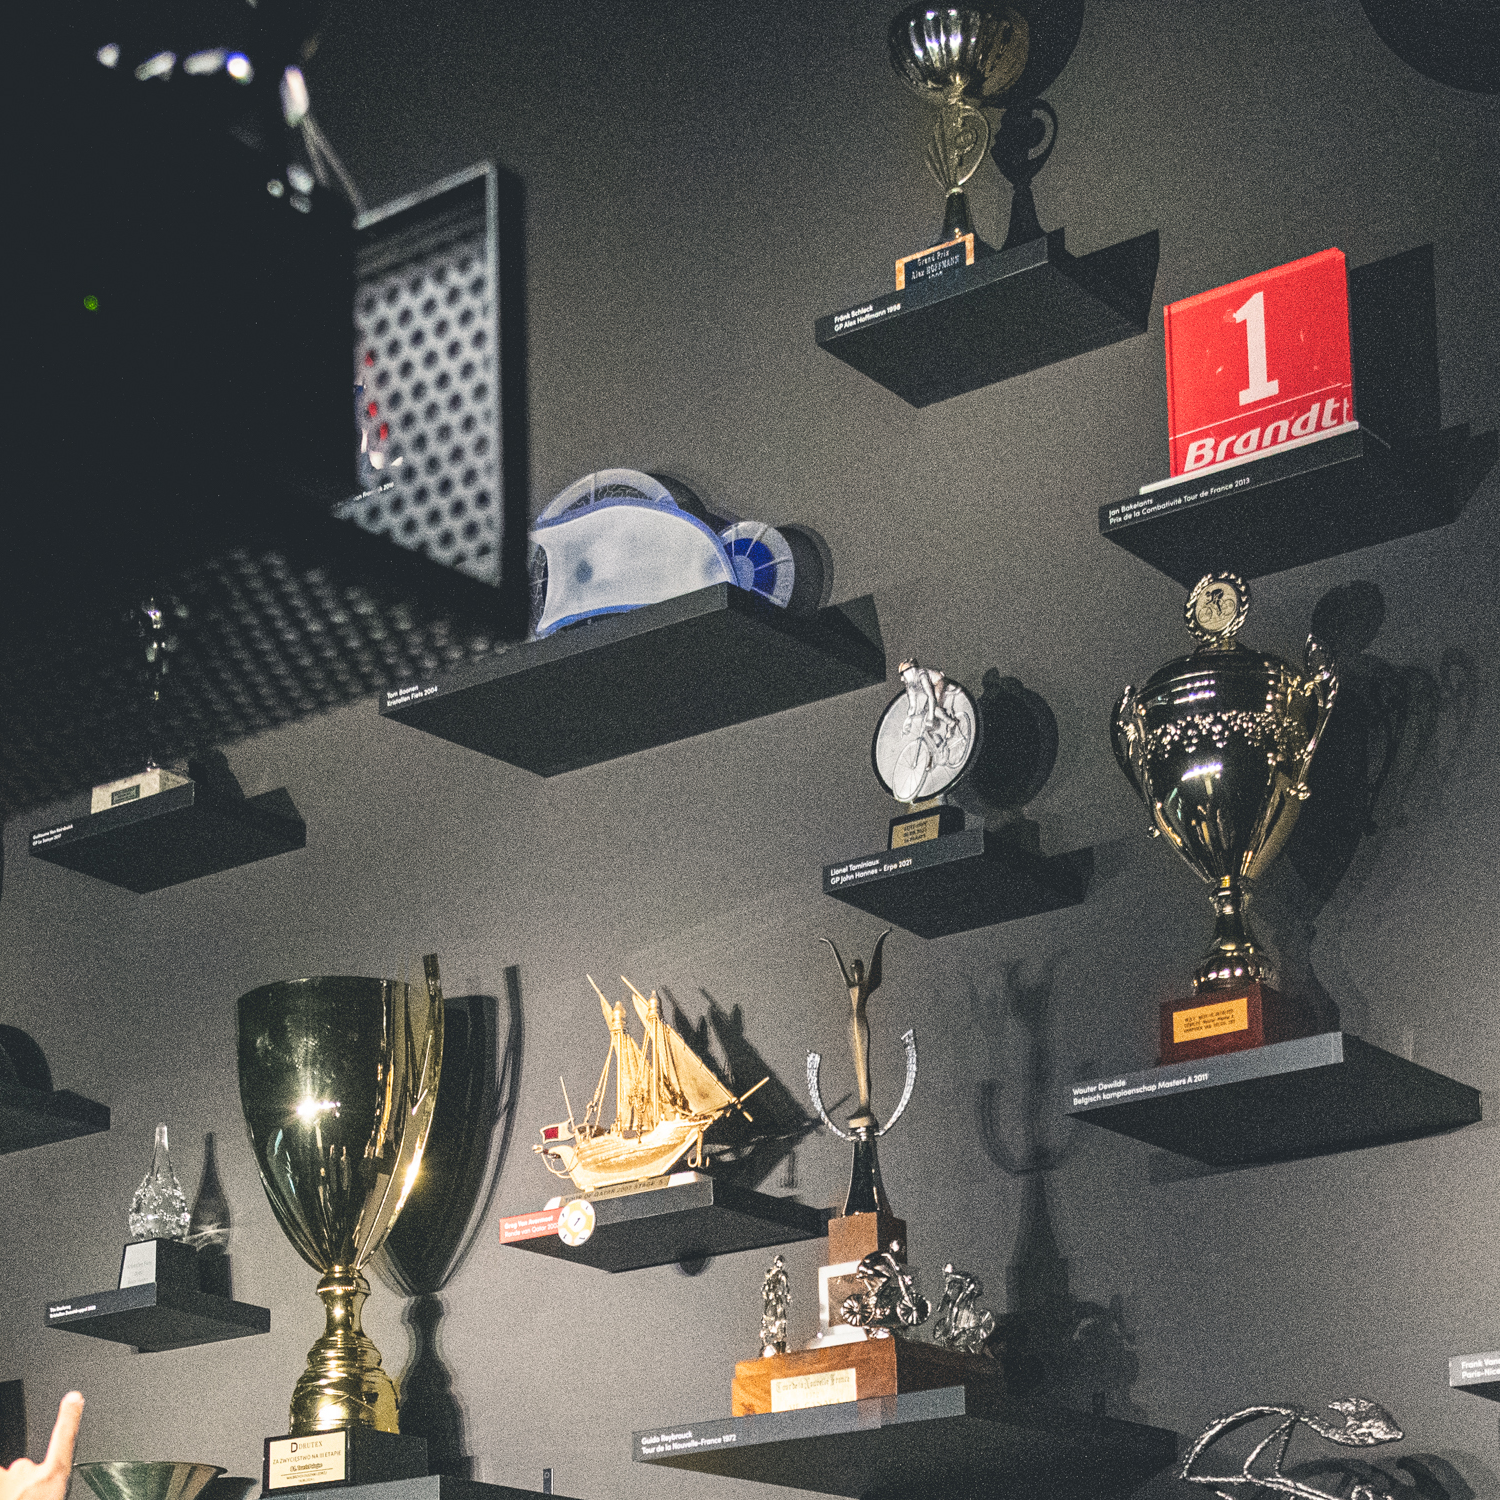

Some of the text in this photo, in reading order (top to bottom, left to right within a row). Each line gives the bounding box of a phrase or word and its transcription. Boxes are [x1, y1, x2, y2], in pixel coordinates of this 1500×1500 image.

[1232, 290, 1281, 407] 1
[1184, 397, 1341, 473] Brandt
[1109, 515, 1122, 525] Prix
[1183, 493, 1198, 503] Tour
[1210, 483, 1233, 495] France
[1234, 477, 1250, 488] 2013
[1108, 498, 1153, 519] Jan Bakelants
[830, 865, 848, 876] Lionel
[840, 874, 854, 884] John
[1072, 1079, 1127, 1096] Wouter Dewilde
[1073, 1094, 1101, 1106] Belgisch
[1102, 1083, 1157, 1100] kampioenschap
[1157, 1077, 1186, 1090] Masters
[1461, 1359, 1483, 1370] Frank
[298, 1440, 323, 1451] DRUTEX
[641, 1434, 660, 1445] Guido
[641, 1445, 656, 1454] Tour
